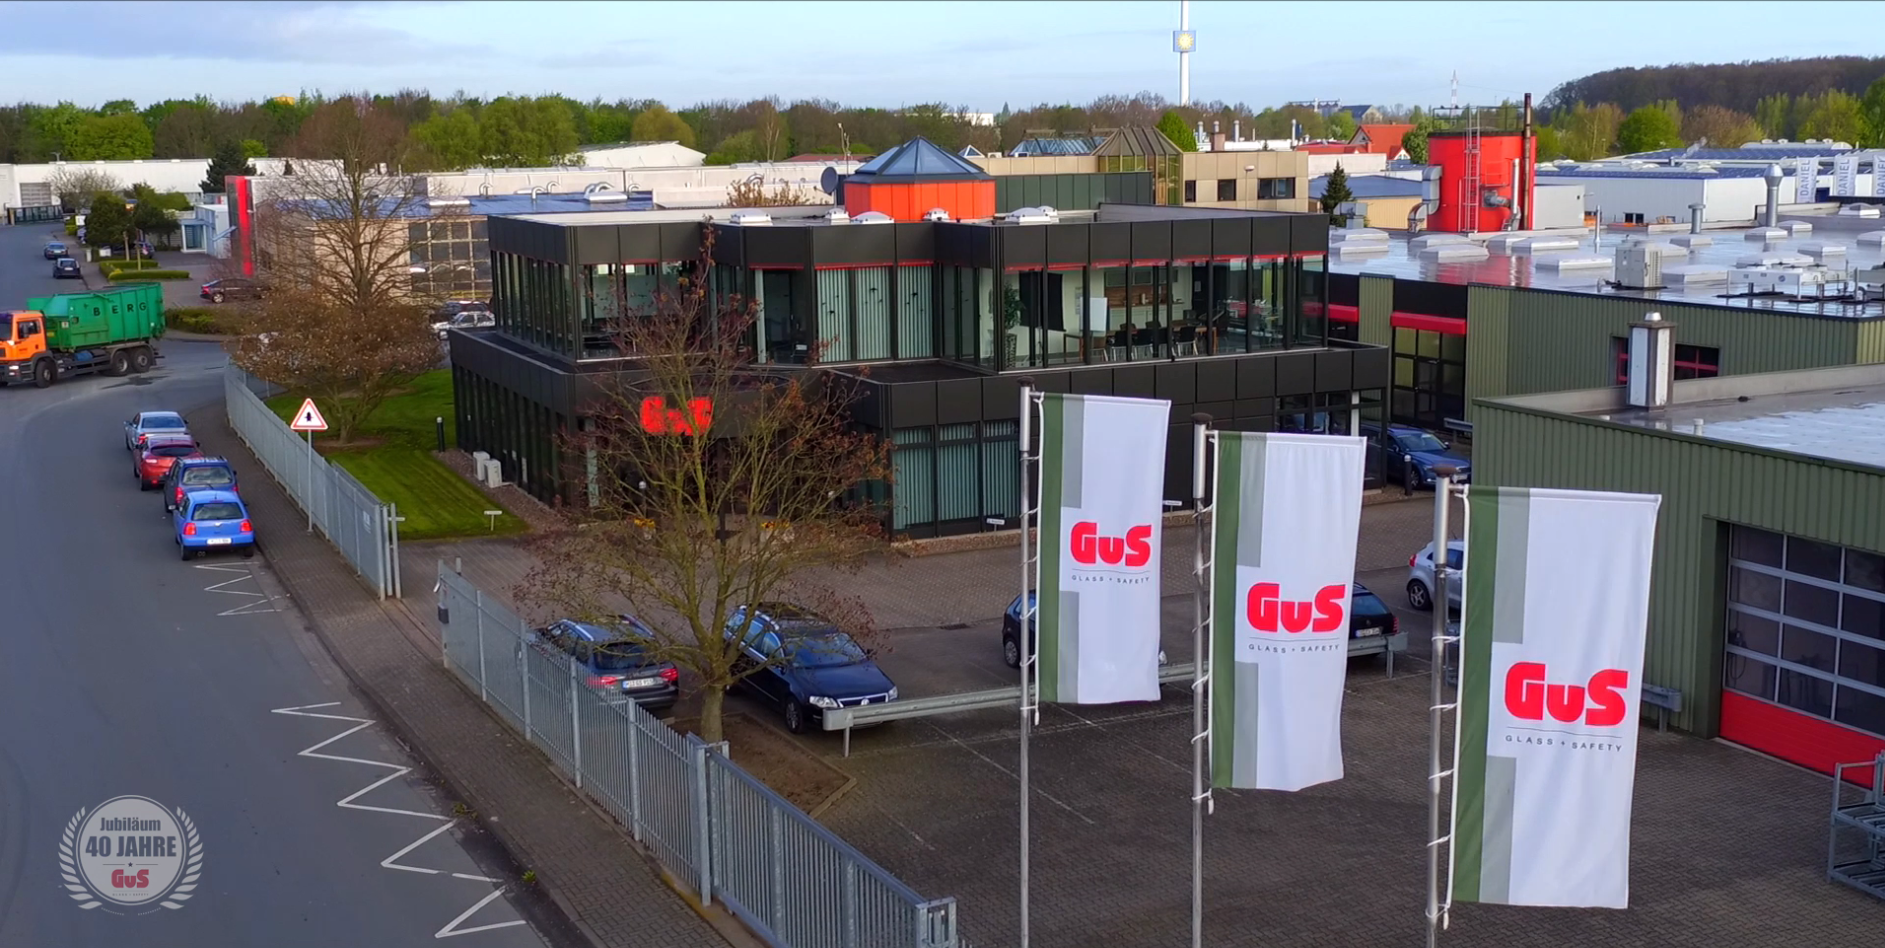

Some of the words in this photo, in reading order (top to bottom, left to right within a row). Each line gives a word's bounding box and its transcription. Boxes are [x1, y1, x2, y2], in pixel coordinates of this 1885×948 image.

[1800, 159, 1811, 196] DANIEL
[1838, 159, 1850, 196] DANIEL
[93, 302, 147, 317] BERG
[1070, 521, 1152, 566] GuS
[1071, 574, 1104, 582] GLASS
[1117, 576, 1150, 584] SAFETY
[1246, 582, 1346, 633] GuS
[1248, 643, 1287, 654] GLASS
[1300, 644, 1340, 653] SAFETY
[1504, 661, 1628, 726] GuS
[1505, 735, 1554, 746] GLASS
[1571, 741, 1622, 752] SAFETY
